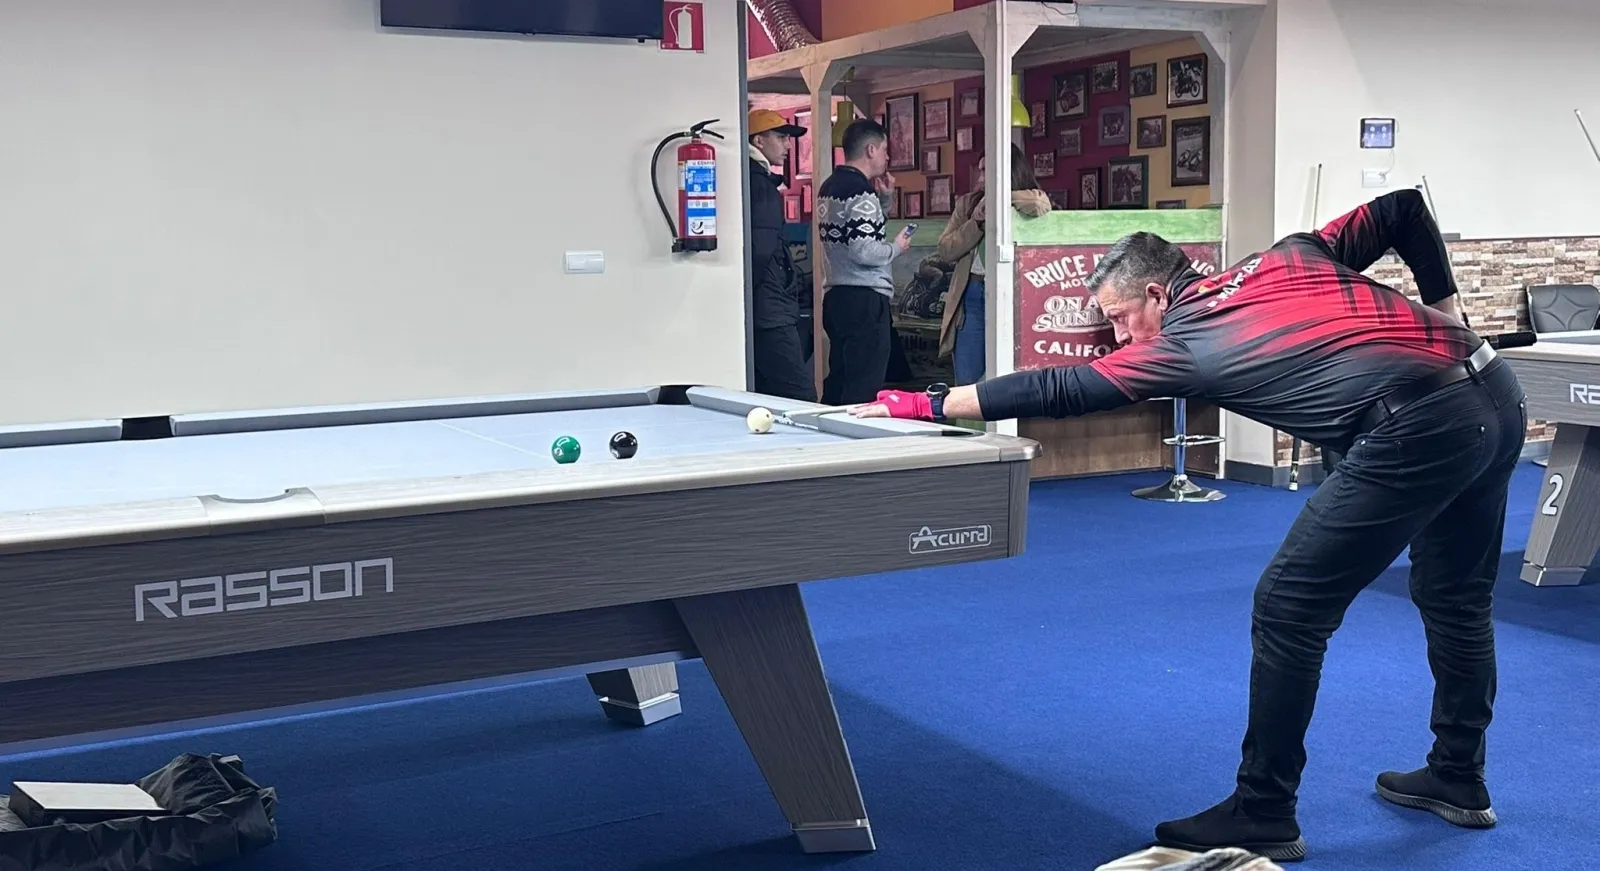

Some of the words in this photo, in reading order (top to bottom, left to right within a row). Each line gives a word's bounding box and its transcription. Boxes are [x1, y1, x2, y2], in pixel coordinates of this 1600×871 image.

[1023, 254, 1089, 288] BRUCE
[1044, 295, 1084, 314] ON
[1033, 340, 1113, 358] CALIFO
[1541, 473, 1563, 516] 2
